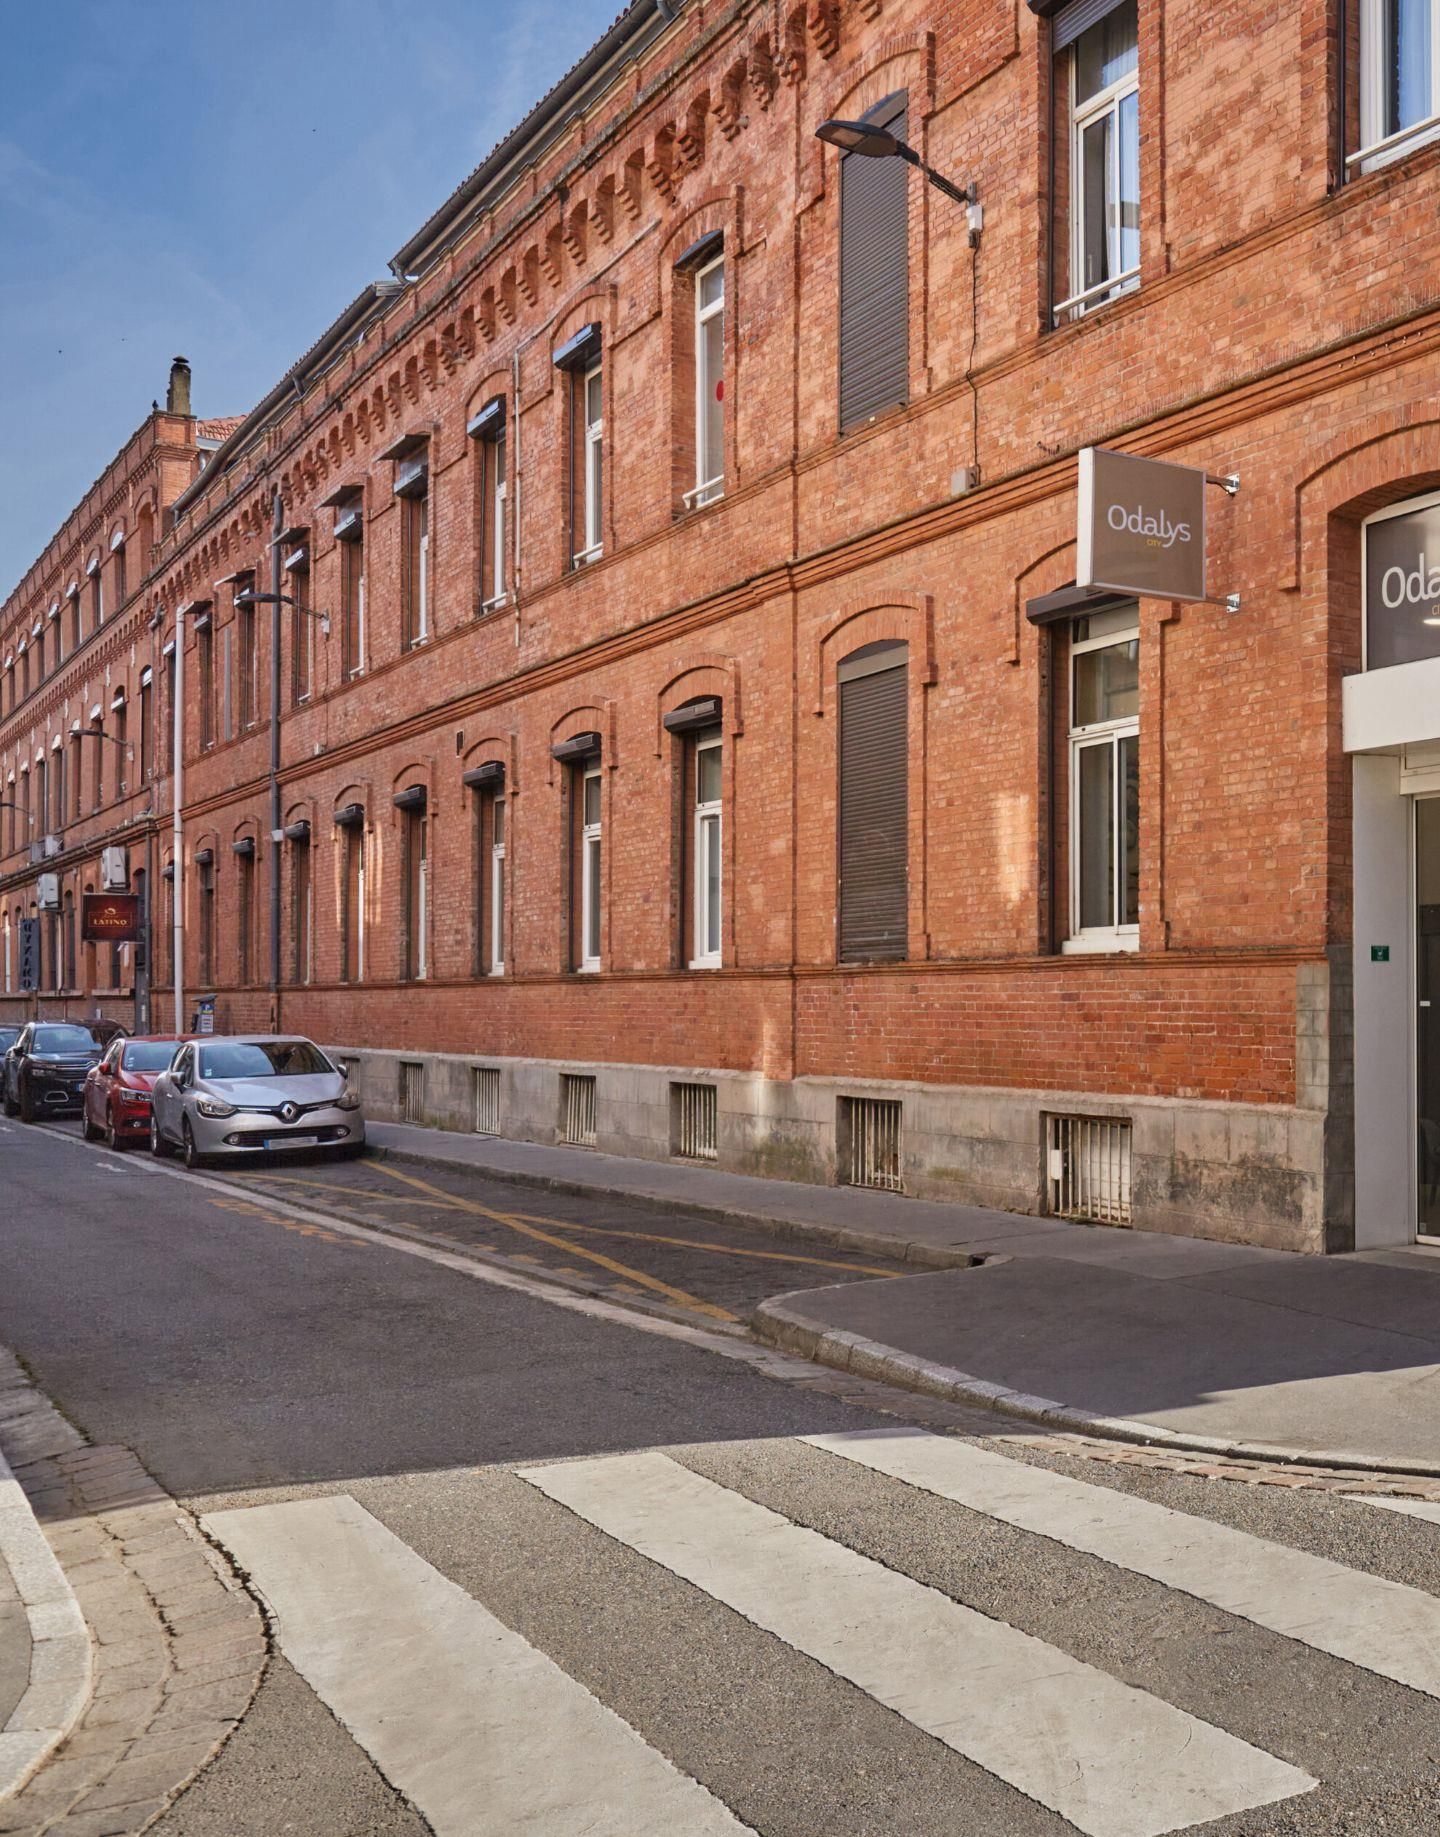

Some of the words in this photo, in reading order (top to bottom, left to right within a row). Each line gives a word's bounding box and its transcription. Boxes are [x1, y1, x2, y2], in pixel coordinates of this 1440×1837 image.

[1107, 504, 1191, 548] Odalys
[1146, 538, 1161, 546] CITY
[93, 918, 127, 926] LATINO
